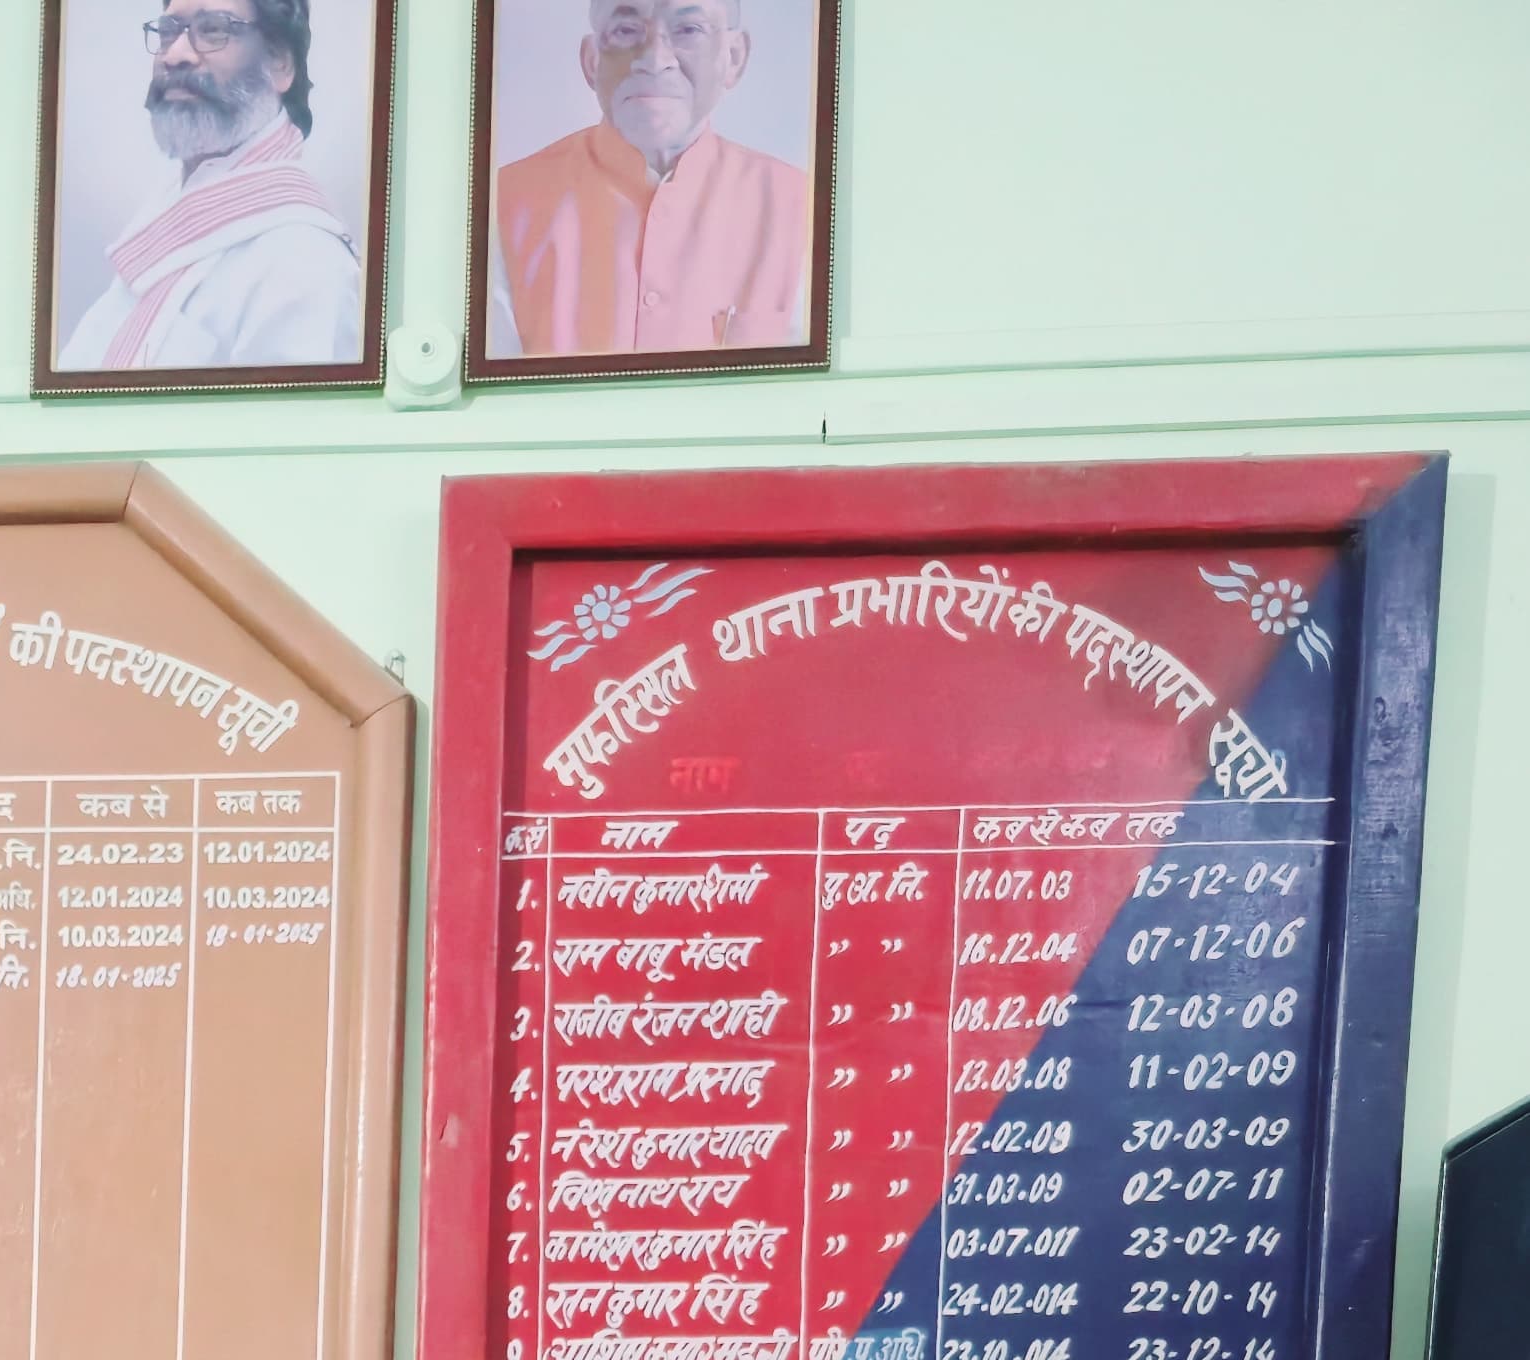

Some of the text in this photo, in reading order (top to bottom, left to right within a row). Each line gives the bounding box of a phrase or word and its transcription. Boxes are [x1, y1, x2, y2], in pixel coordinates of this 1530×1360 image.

[9, 611, 65, 670] की
[65, 630, 232, 718] पदस्थापन
[218, 686, 299, 755] सूची
[712, 586, 824, 662] थाना
[829, 560, 1015, 641] प्रभारियों
[1008, 581, 1068, 643] की
[1064, 603, 1217, 725] पदस्थापन
[1209, 708, 1287, 804] सूची
[77, 792, 134, 818] कब
[140, 785, 170, 818] से
[214, 790, 257, 815] कब
[261, 789, 302, 815] तक
[601, 821, 679, 850] नाम
[845, 816, 905, 850] पद
[1126, 811, 1184, 840] तक
[57, 843, 184, 866] 24.02.23
[204, 840, 330, 863] 12.01.2024
[58, 886, 183, 908] 12.01.2024
[204, 886, 330, 908] 10.03.2024
[58, 925, 183, 948] 10.03.2024
[553, 939, 620, 977] राम
[681, 932, 762, 971] मंडल
[689, 1273, 769, 1326] सिंह
